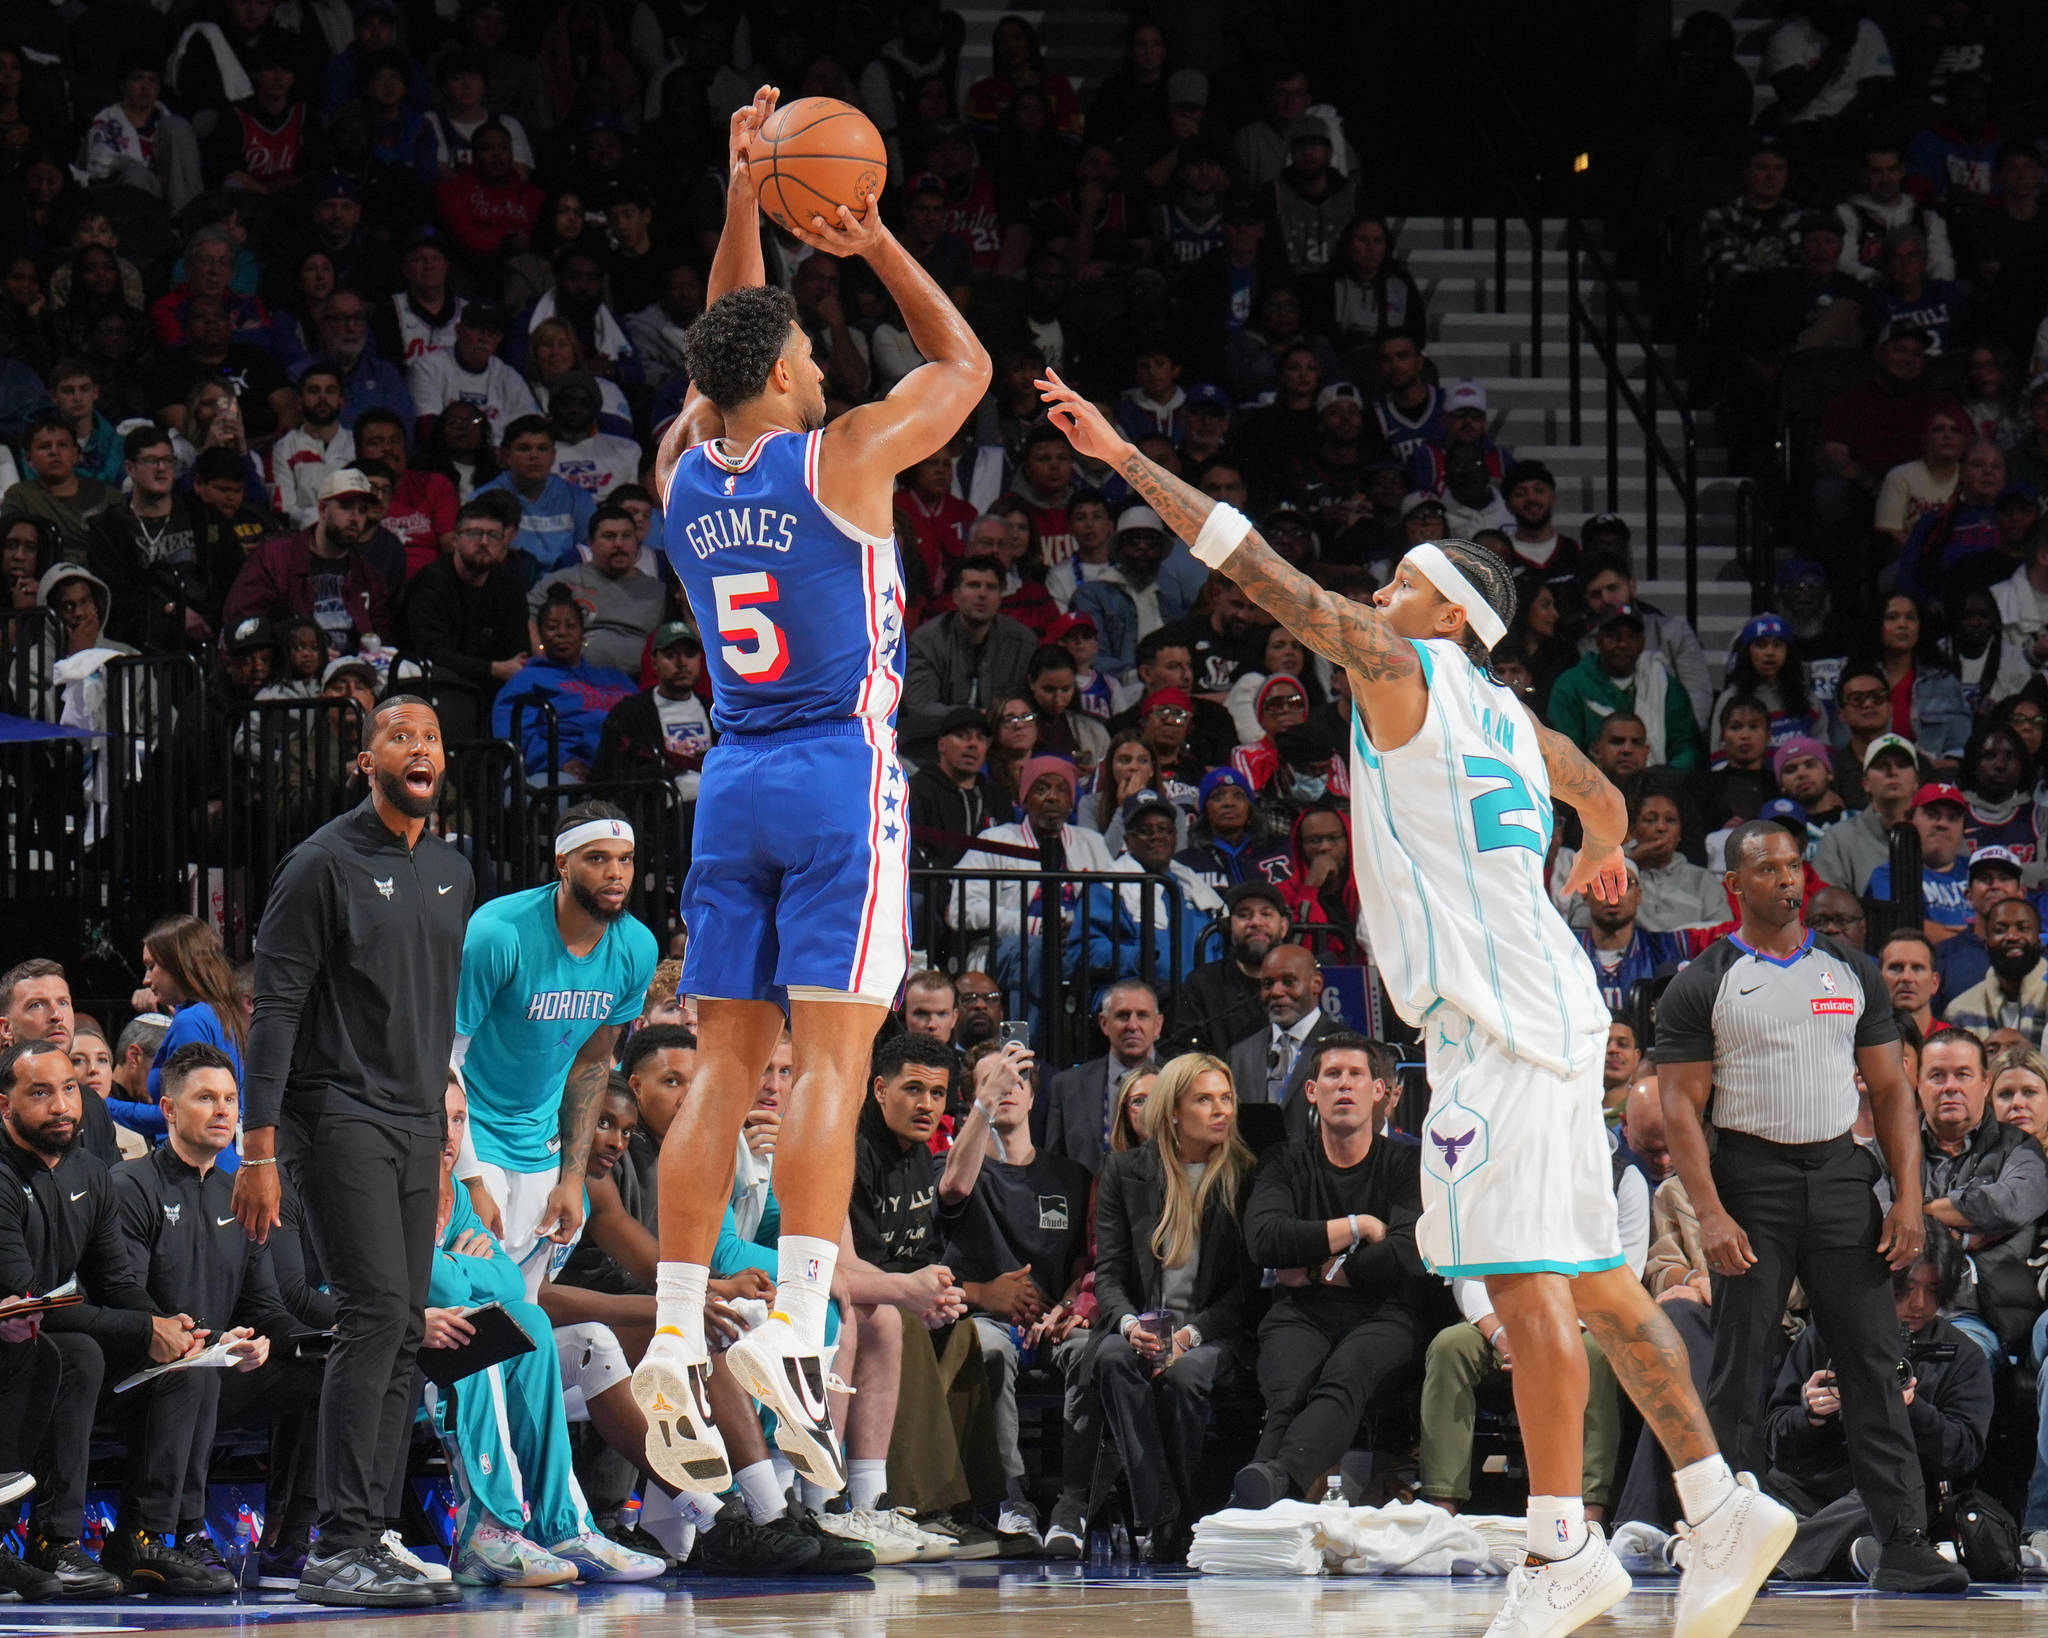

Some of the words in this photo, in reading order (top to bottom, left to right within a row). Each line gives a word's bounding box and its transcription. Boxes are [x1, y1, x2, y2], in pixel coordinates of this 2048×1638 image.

[684, 507, 797, 560] GRIMES
[711, 571, 791, 685] 5
[526, 989, 615, 1022] HORNETS
[1812, 1001, 1854, 1012] Emirates
[1041, 1215, 1068, 1229] Rhude
